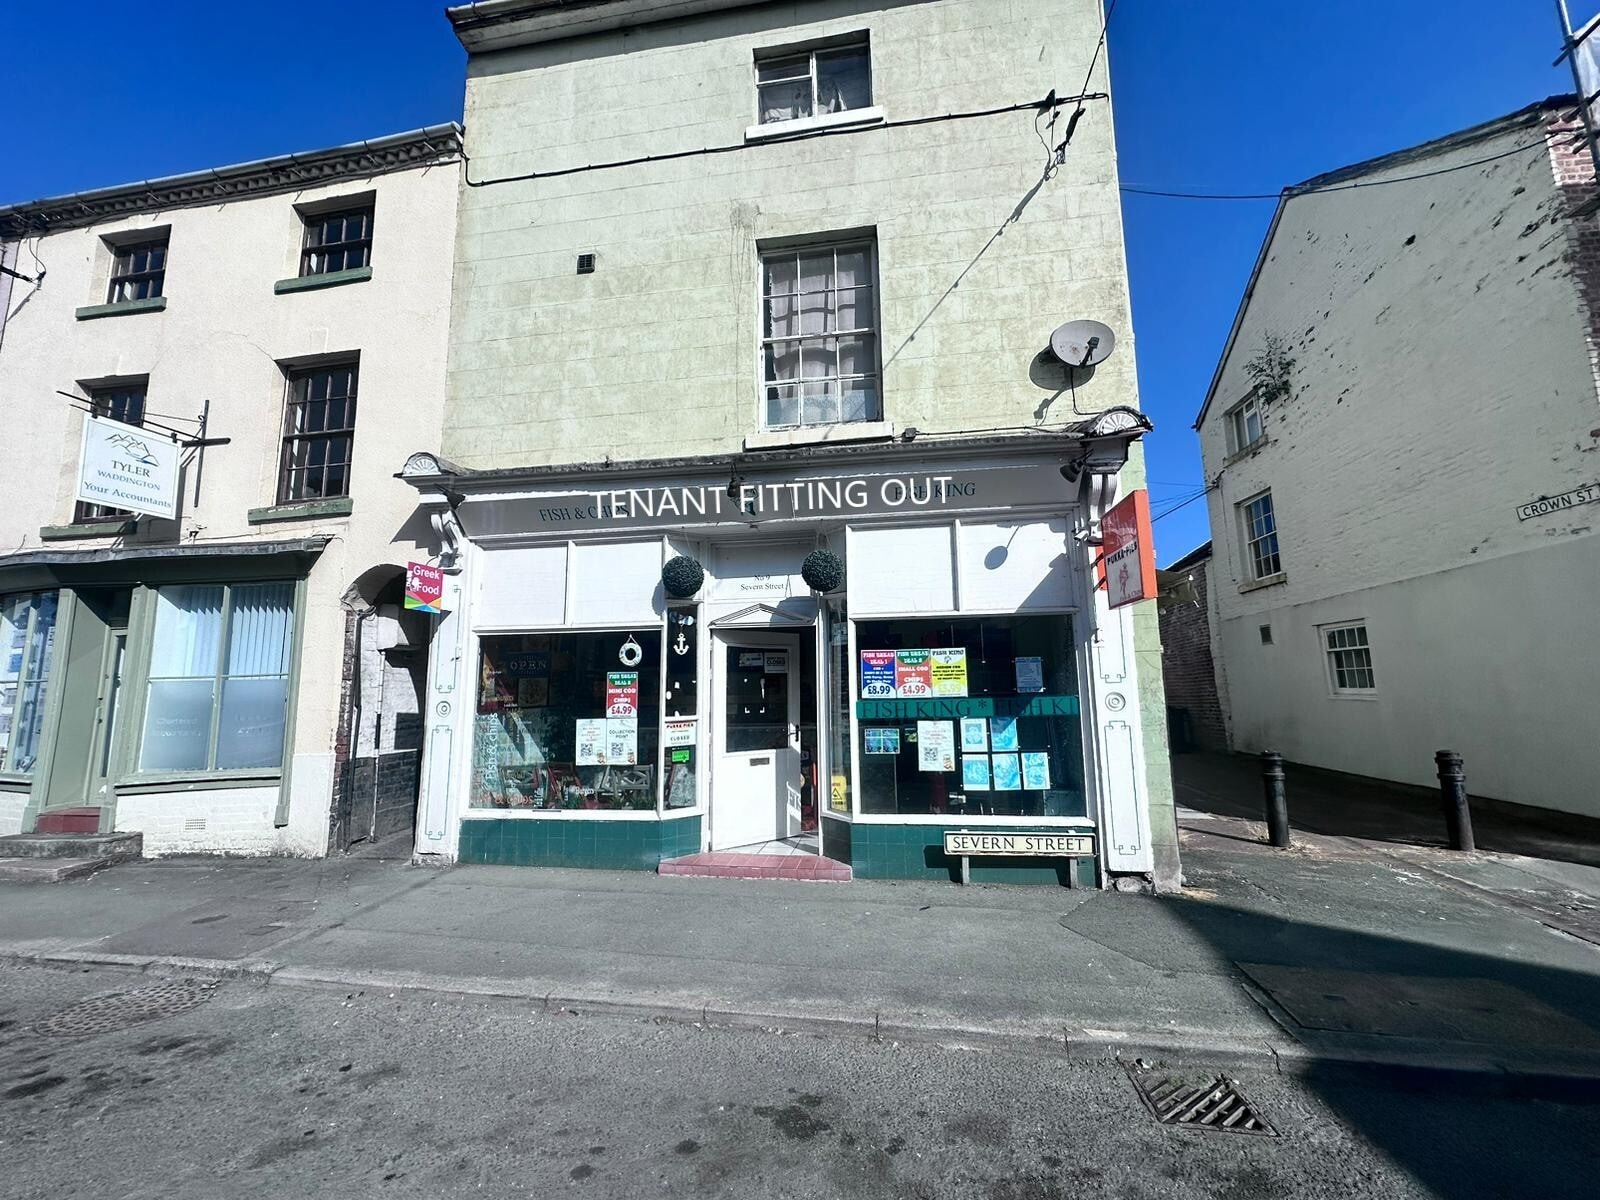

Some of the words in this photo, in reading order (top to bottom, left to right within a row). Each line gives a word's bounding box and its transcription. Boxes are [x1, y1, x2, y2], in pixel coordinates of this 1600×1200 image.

[112, 460, 150, 478] TYLER
[98, 470, 160, 490] WADDINGTON
[84, 481, 109, 494] Your
[112, 489, 172, 508] Accountants
[934, 482, 976, 498] KING
[1523, 495, 1572, 516] CROWN
[1577, 488, 1593, 502] ST
[539, 507, 571, 521] FISH
[574, 505, 586, 519] &
[413, 565, 440, 580] Greek
[416, 585, 440, 595] Food
[741, 583, 763, 591] Severn
[510, 661, 546, 672] OPEN
[867, 685, 891, 695] £8.99
[902, 685, 926, 695] £4.99
[611, 706, 633, 715] £4.99
[861, 702, 908, 719] FISH
[917, 699, 971, 719] KING
[953, 836, 1014, 849] SEVERN
[1026, 837, 1085, 850] STREET
